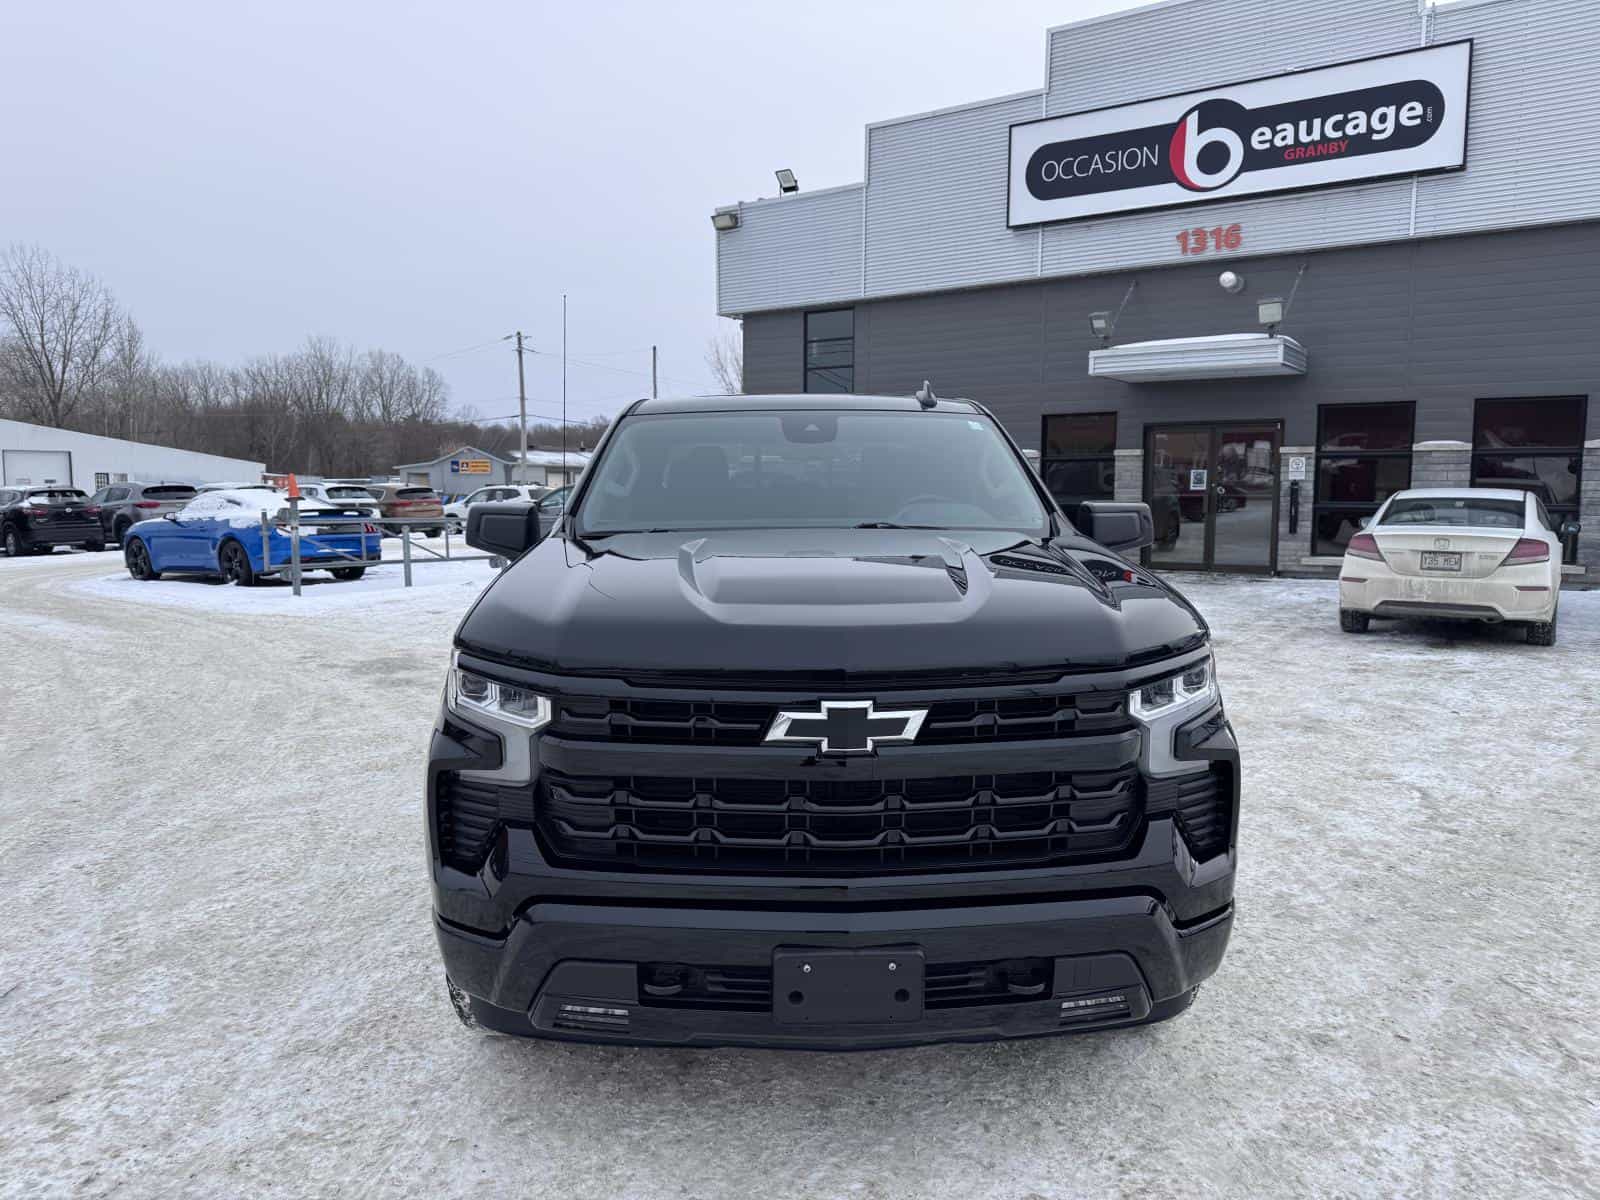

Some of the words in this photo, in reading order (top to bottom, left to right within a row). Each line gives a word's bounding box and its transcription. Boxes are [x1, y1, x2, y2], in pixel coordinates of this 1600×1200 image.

[1041, 144, 1159, 183] OCCASION
[1283, 140, 1349, 161] GRANBY
[1176, 224, 1243, 255] 1316
